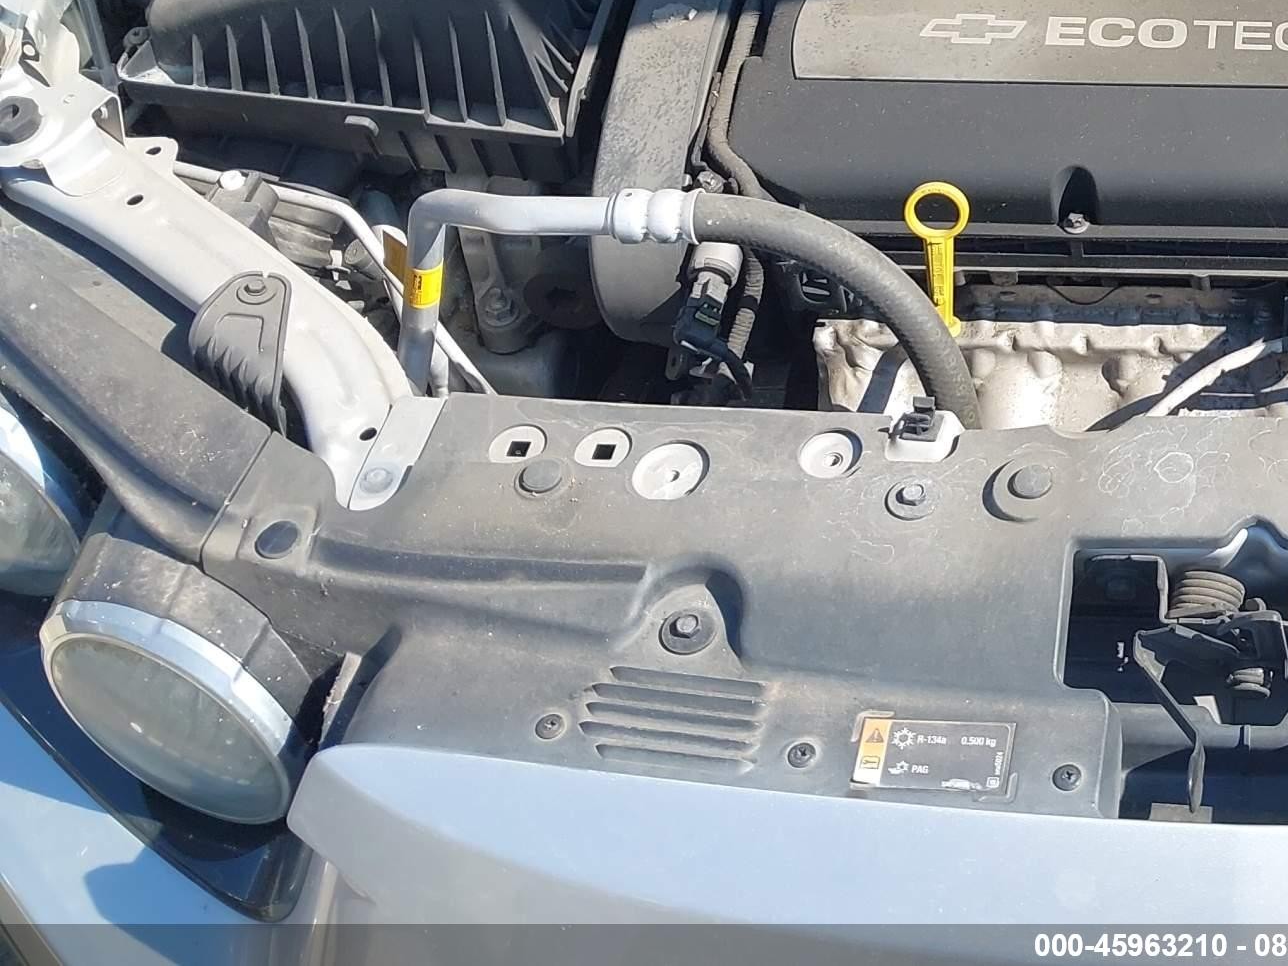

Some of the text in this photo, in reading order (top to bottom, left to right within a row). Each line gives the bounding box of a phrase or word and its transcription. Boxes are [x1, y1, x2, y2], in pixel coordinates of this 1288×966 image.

[916, 735, 997, 748] R-134a 0.500 kg
[911, 764, 930, 774] PAG
